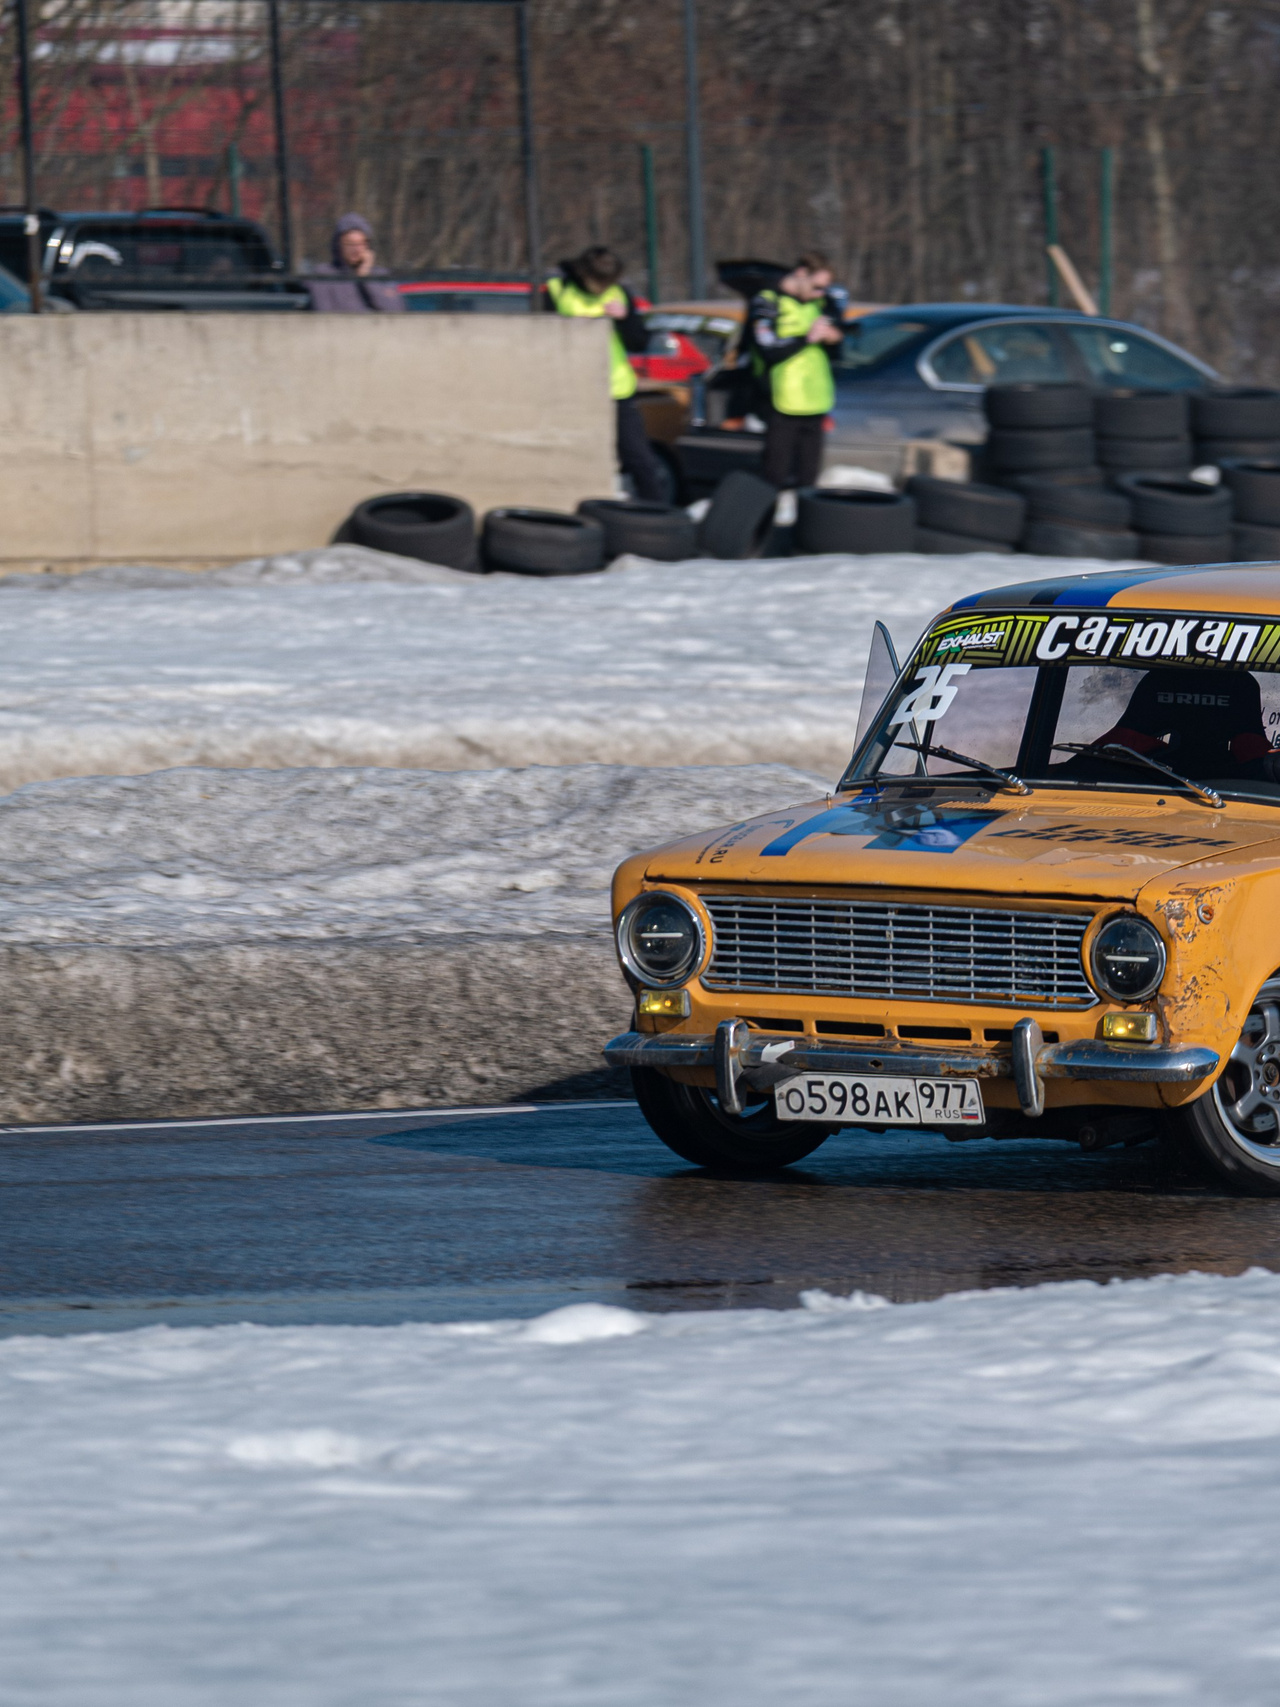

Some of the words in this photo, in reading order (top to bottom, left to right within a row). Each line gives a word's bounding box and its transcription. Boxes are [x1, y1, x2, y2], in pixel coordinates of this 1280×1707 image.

[936, 630, 1005, 654] EXHAUST
[889, 663, 973, 726] 25
[1157, 691, 1231, 707] BRIDE
[918, 1082, 968, 1109] 977
[934, 1109, 961, 1119] RUS
